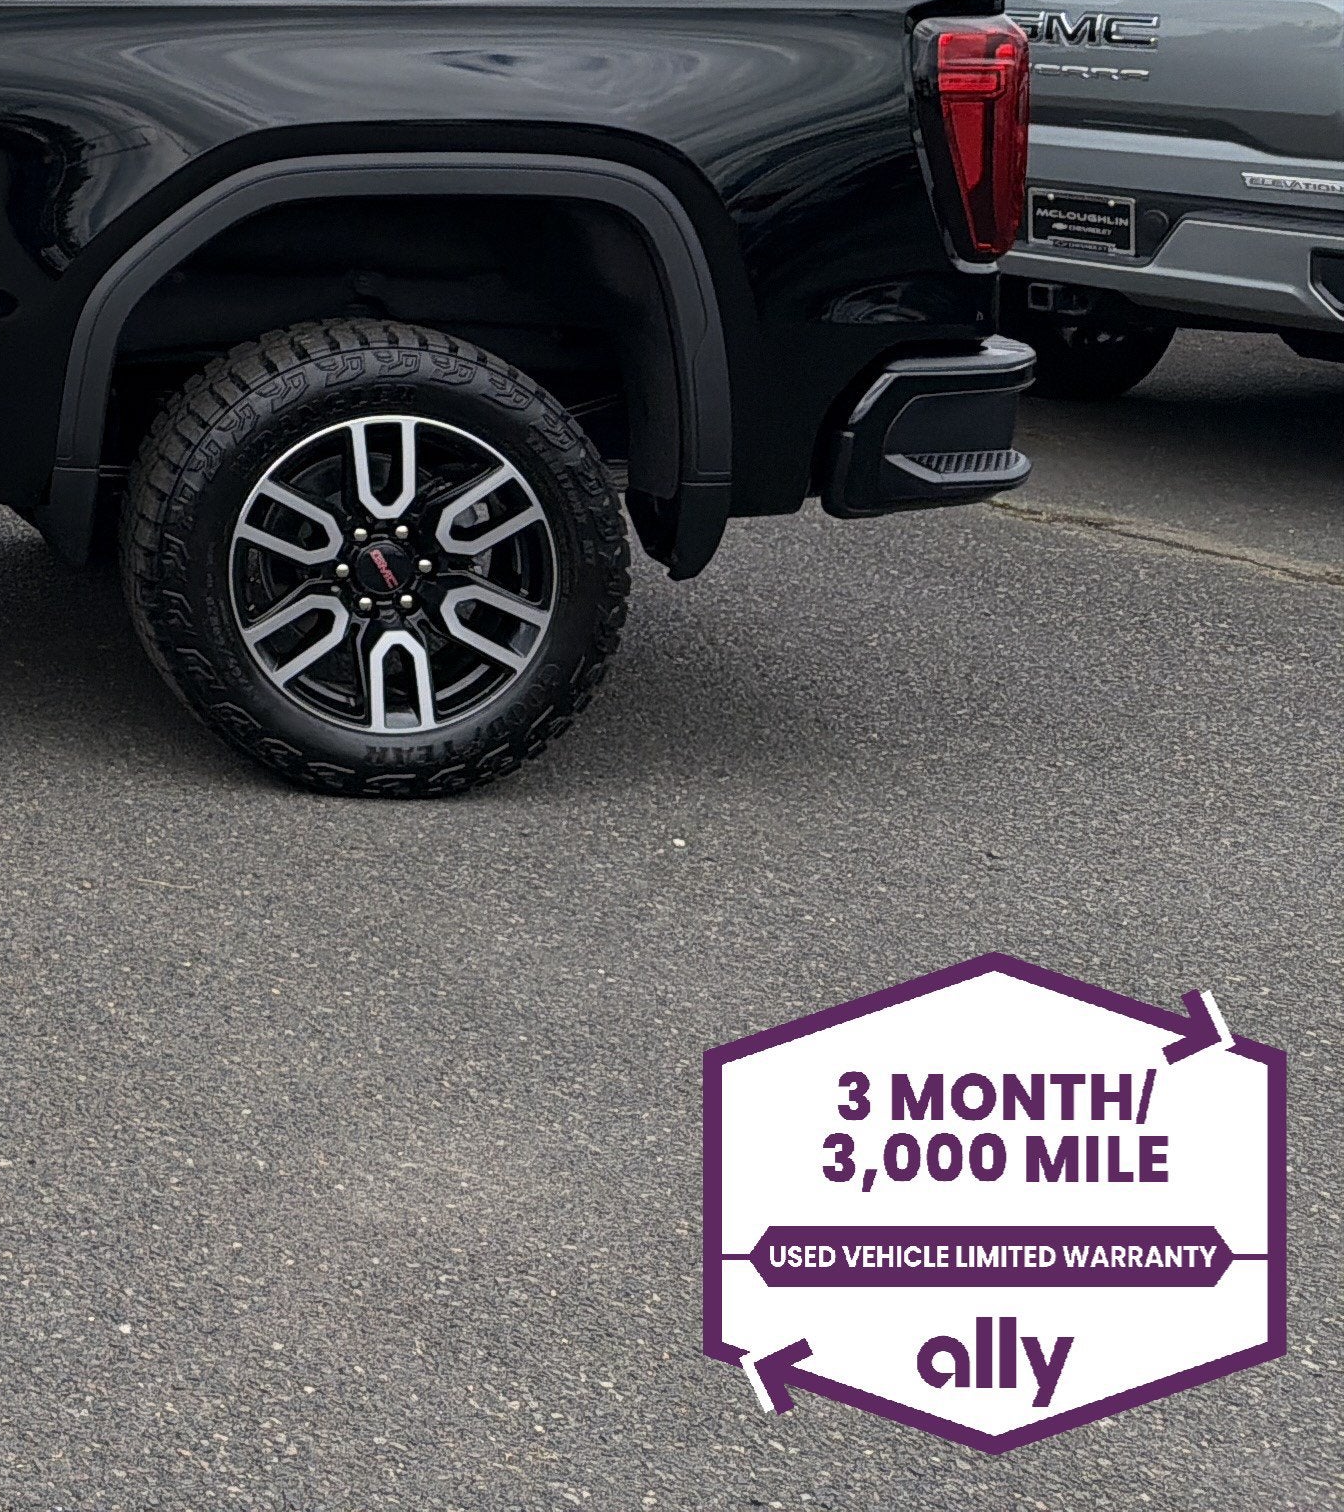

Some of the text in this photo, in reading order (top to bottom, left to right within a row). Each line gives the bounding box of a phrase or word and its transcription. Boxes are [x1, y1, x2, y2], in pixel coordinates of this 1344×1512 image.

[1029, 62, 1151, 82] ERRA
[1035, 207, 1129, 227] MCLOUGHLIN
[369, 548, 400, 590] GMC
